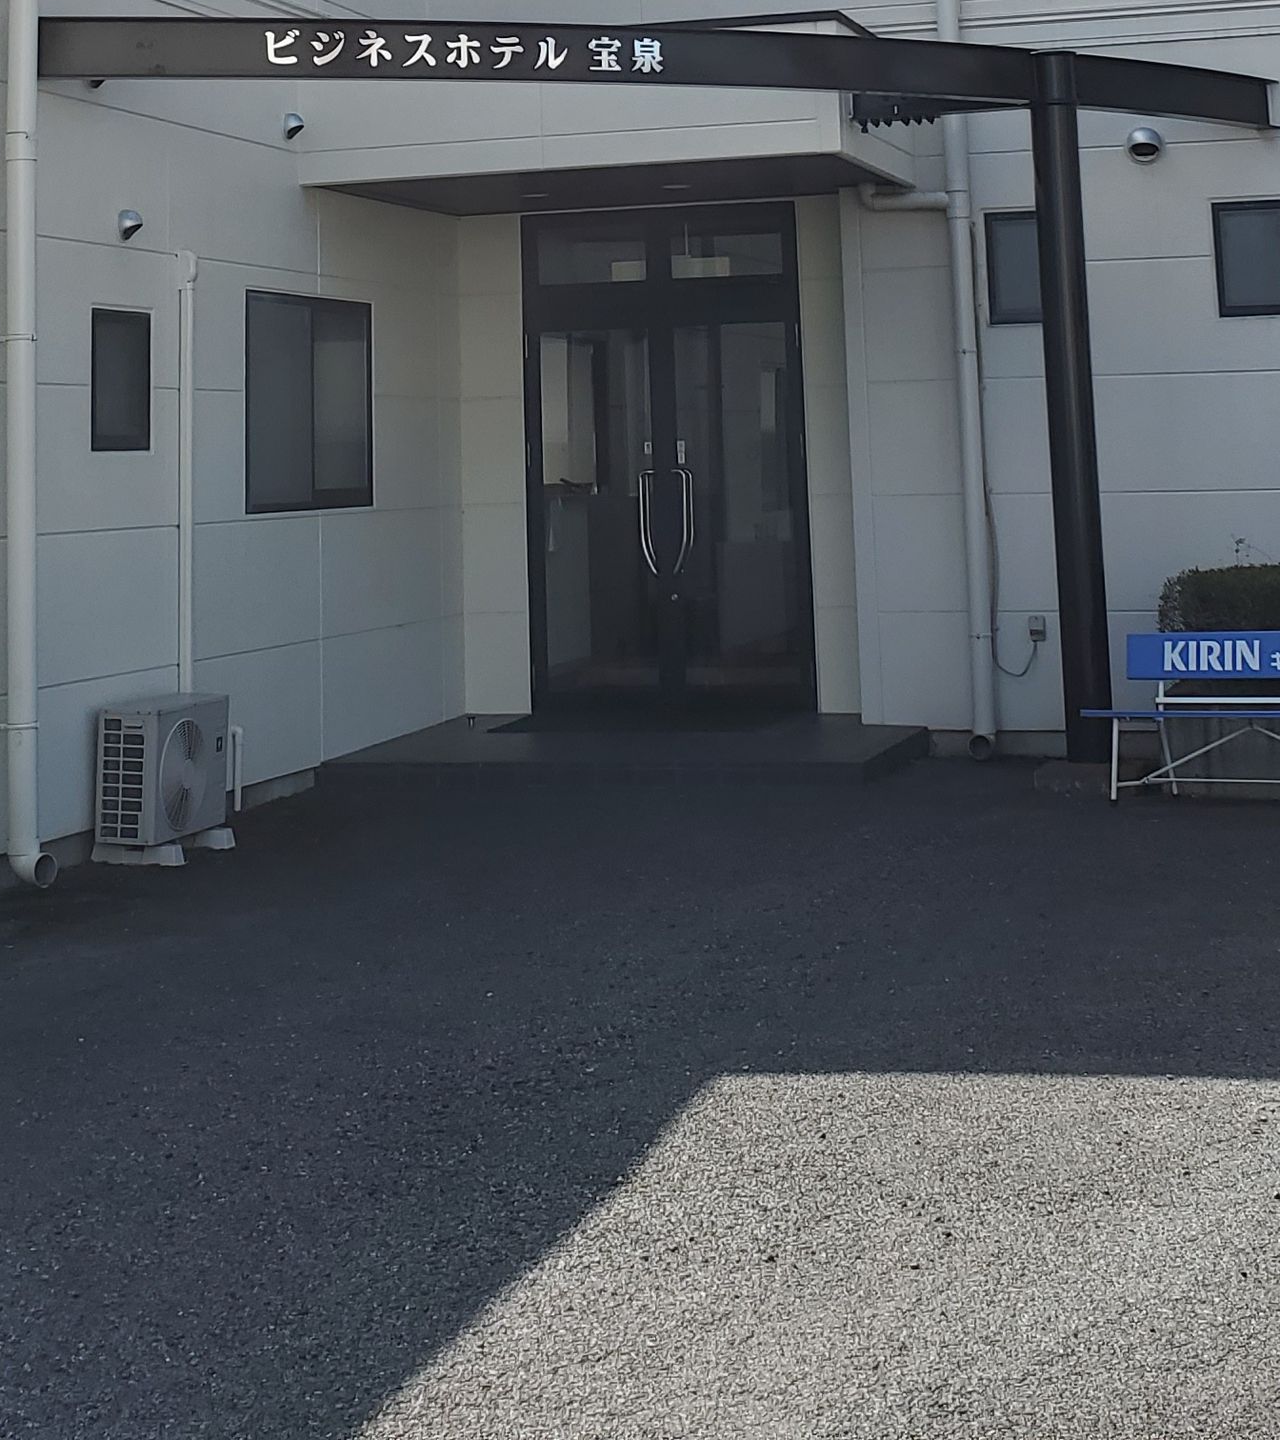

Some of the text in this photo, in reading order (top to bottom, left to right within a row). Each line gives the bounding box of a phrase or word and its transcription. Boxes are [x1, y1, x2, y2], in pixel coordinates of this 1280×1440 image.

[264, 29, 664, 73] ビジネスホテル 宝泉
[1163, 640, 1260, 671] KIRIN
